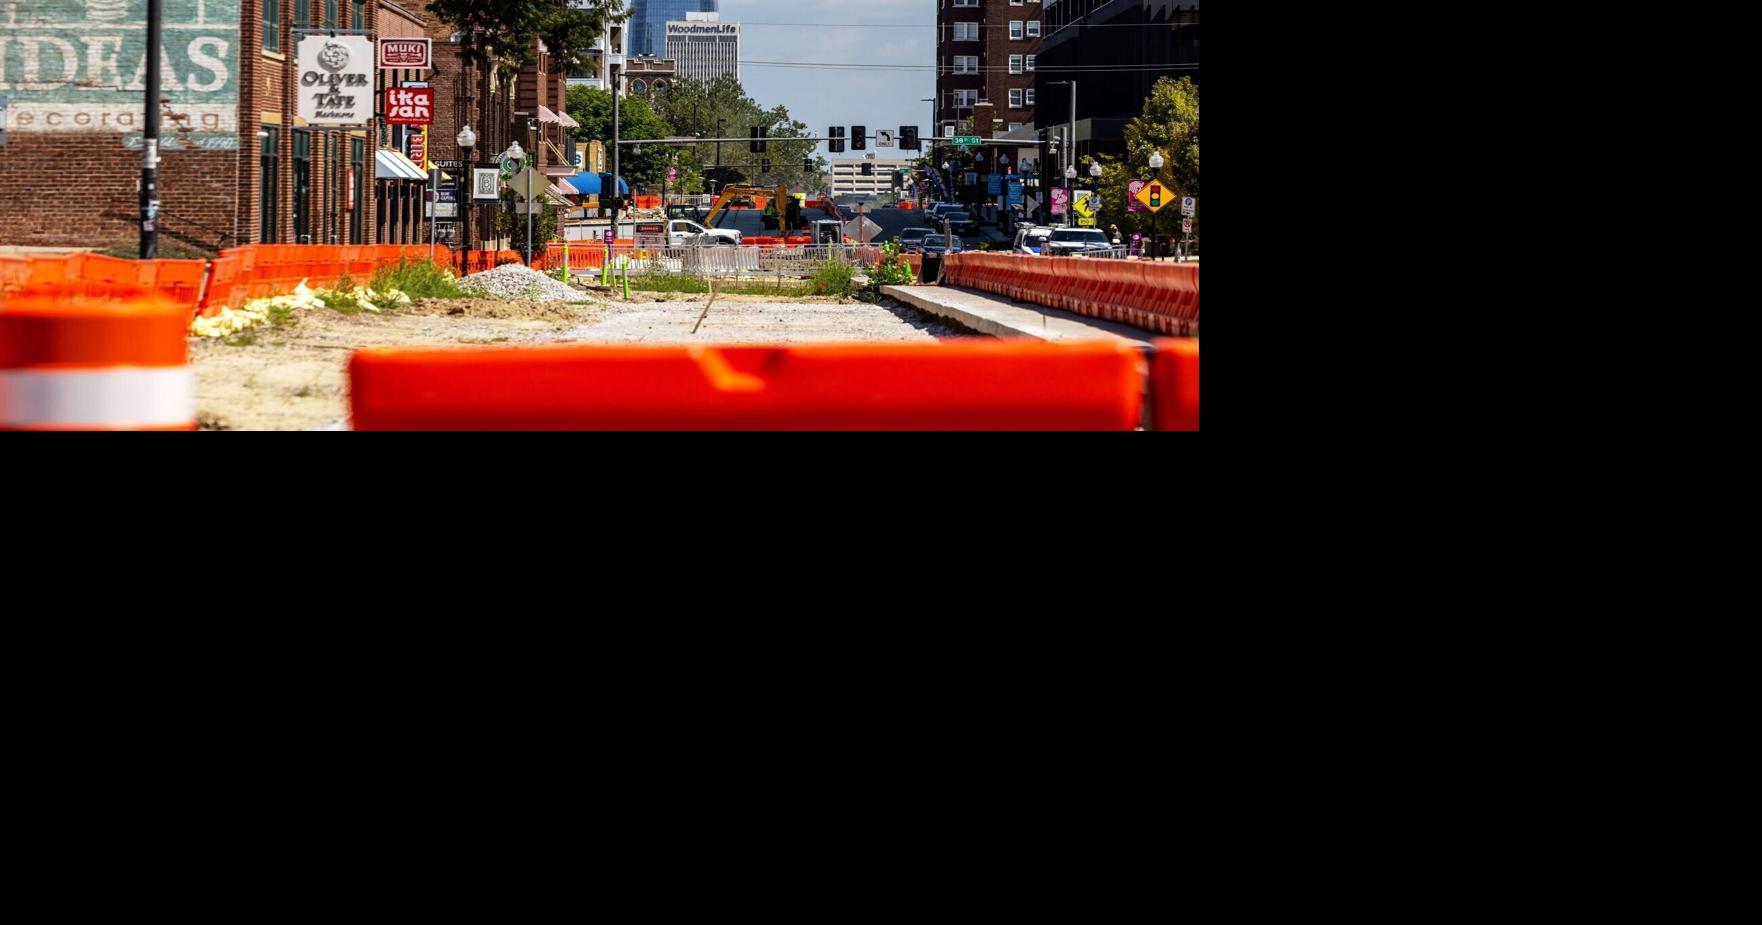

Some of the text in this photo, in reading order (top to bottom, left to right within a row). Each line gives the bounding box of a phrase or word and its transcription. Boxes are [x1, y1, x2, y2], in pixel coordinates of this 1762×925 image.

[668, 24, 736, 34] WoodmenLife
[387, 44, 421, 53] MUKI
[301, 71, 368, 87] OLIVER
[312, 93, 356, 109] TATE
[389, 106, 430, 118] san
[434, 160, 463, 168] SUITES
